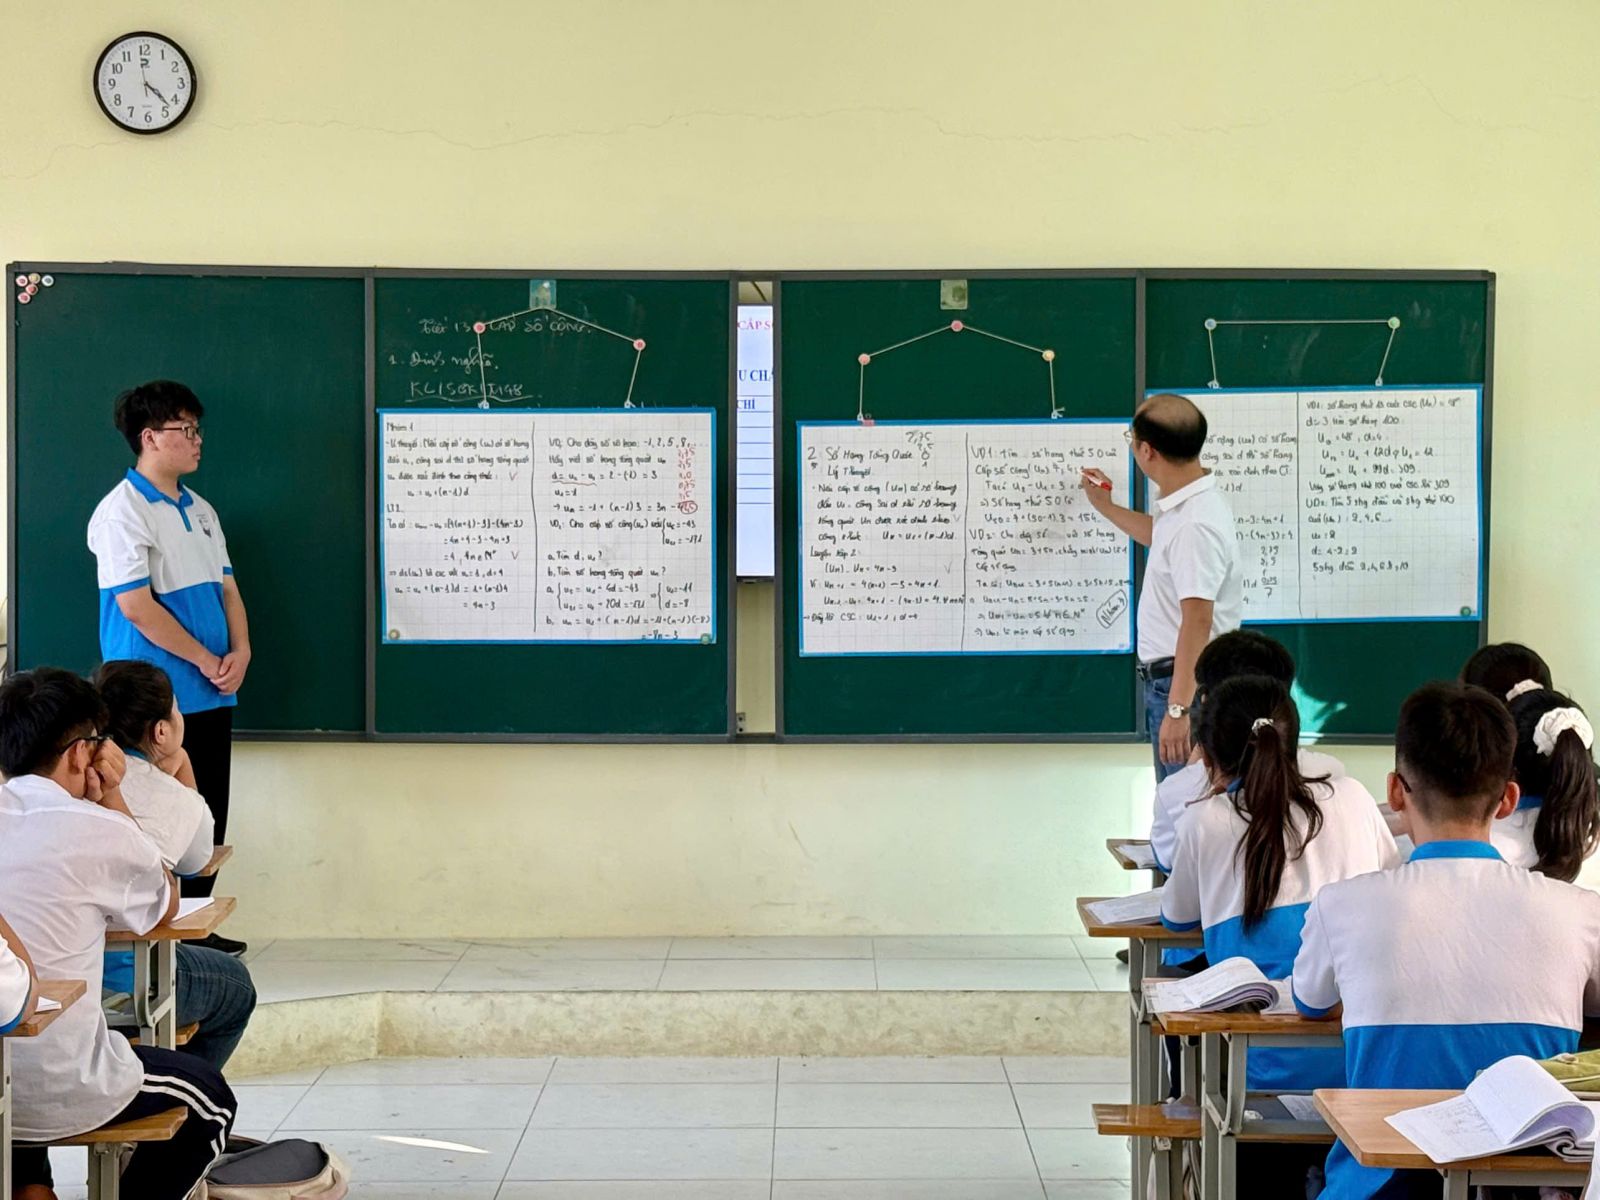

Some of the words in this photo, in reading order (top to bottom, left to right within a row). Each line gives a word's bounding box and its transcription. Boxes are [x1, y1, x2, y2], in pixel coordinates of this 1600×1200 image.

[139, 44, 151, 56] 12
[161, 49, 165, 60] 1
[122, 51, 131, 62] 11
[112, 63, 123, 74] 10
[171, 61, 179, 73] 2
[108, 78, 116, 90] 9
[177, 77, 185, 89] 3
[113, 94, 121, 106] 8
[171, 94, 180, 105] 4
[127, 106, 135, 118] 7
[144, 111, 152, 123] 6
[161, 106, 169, 118] 5
